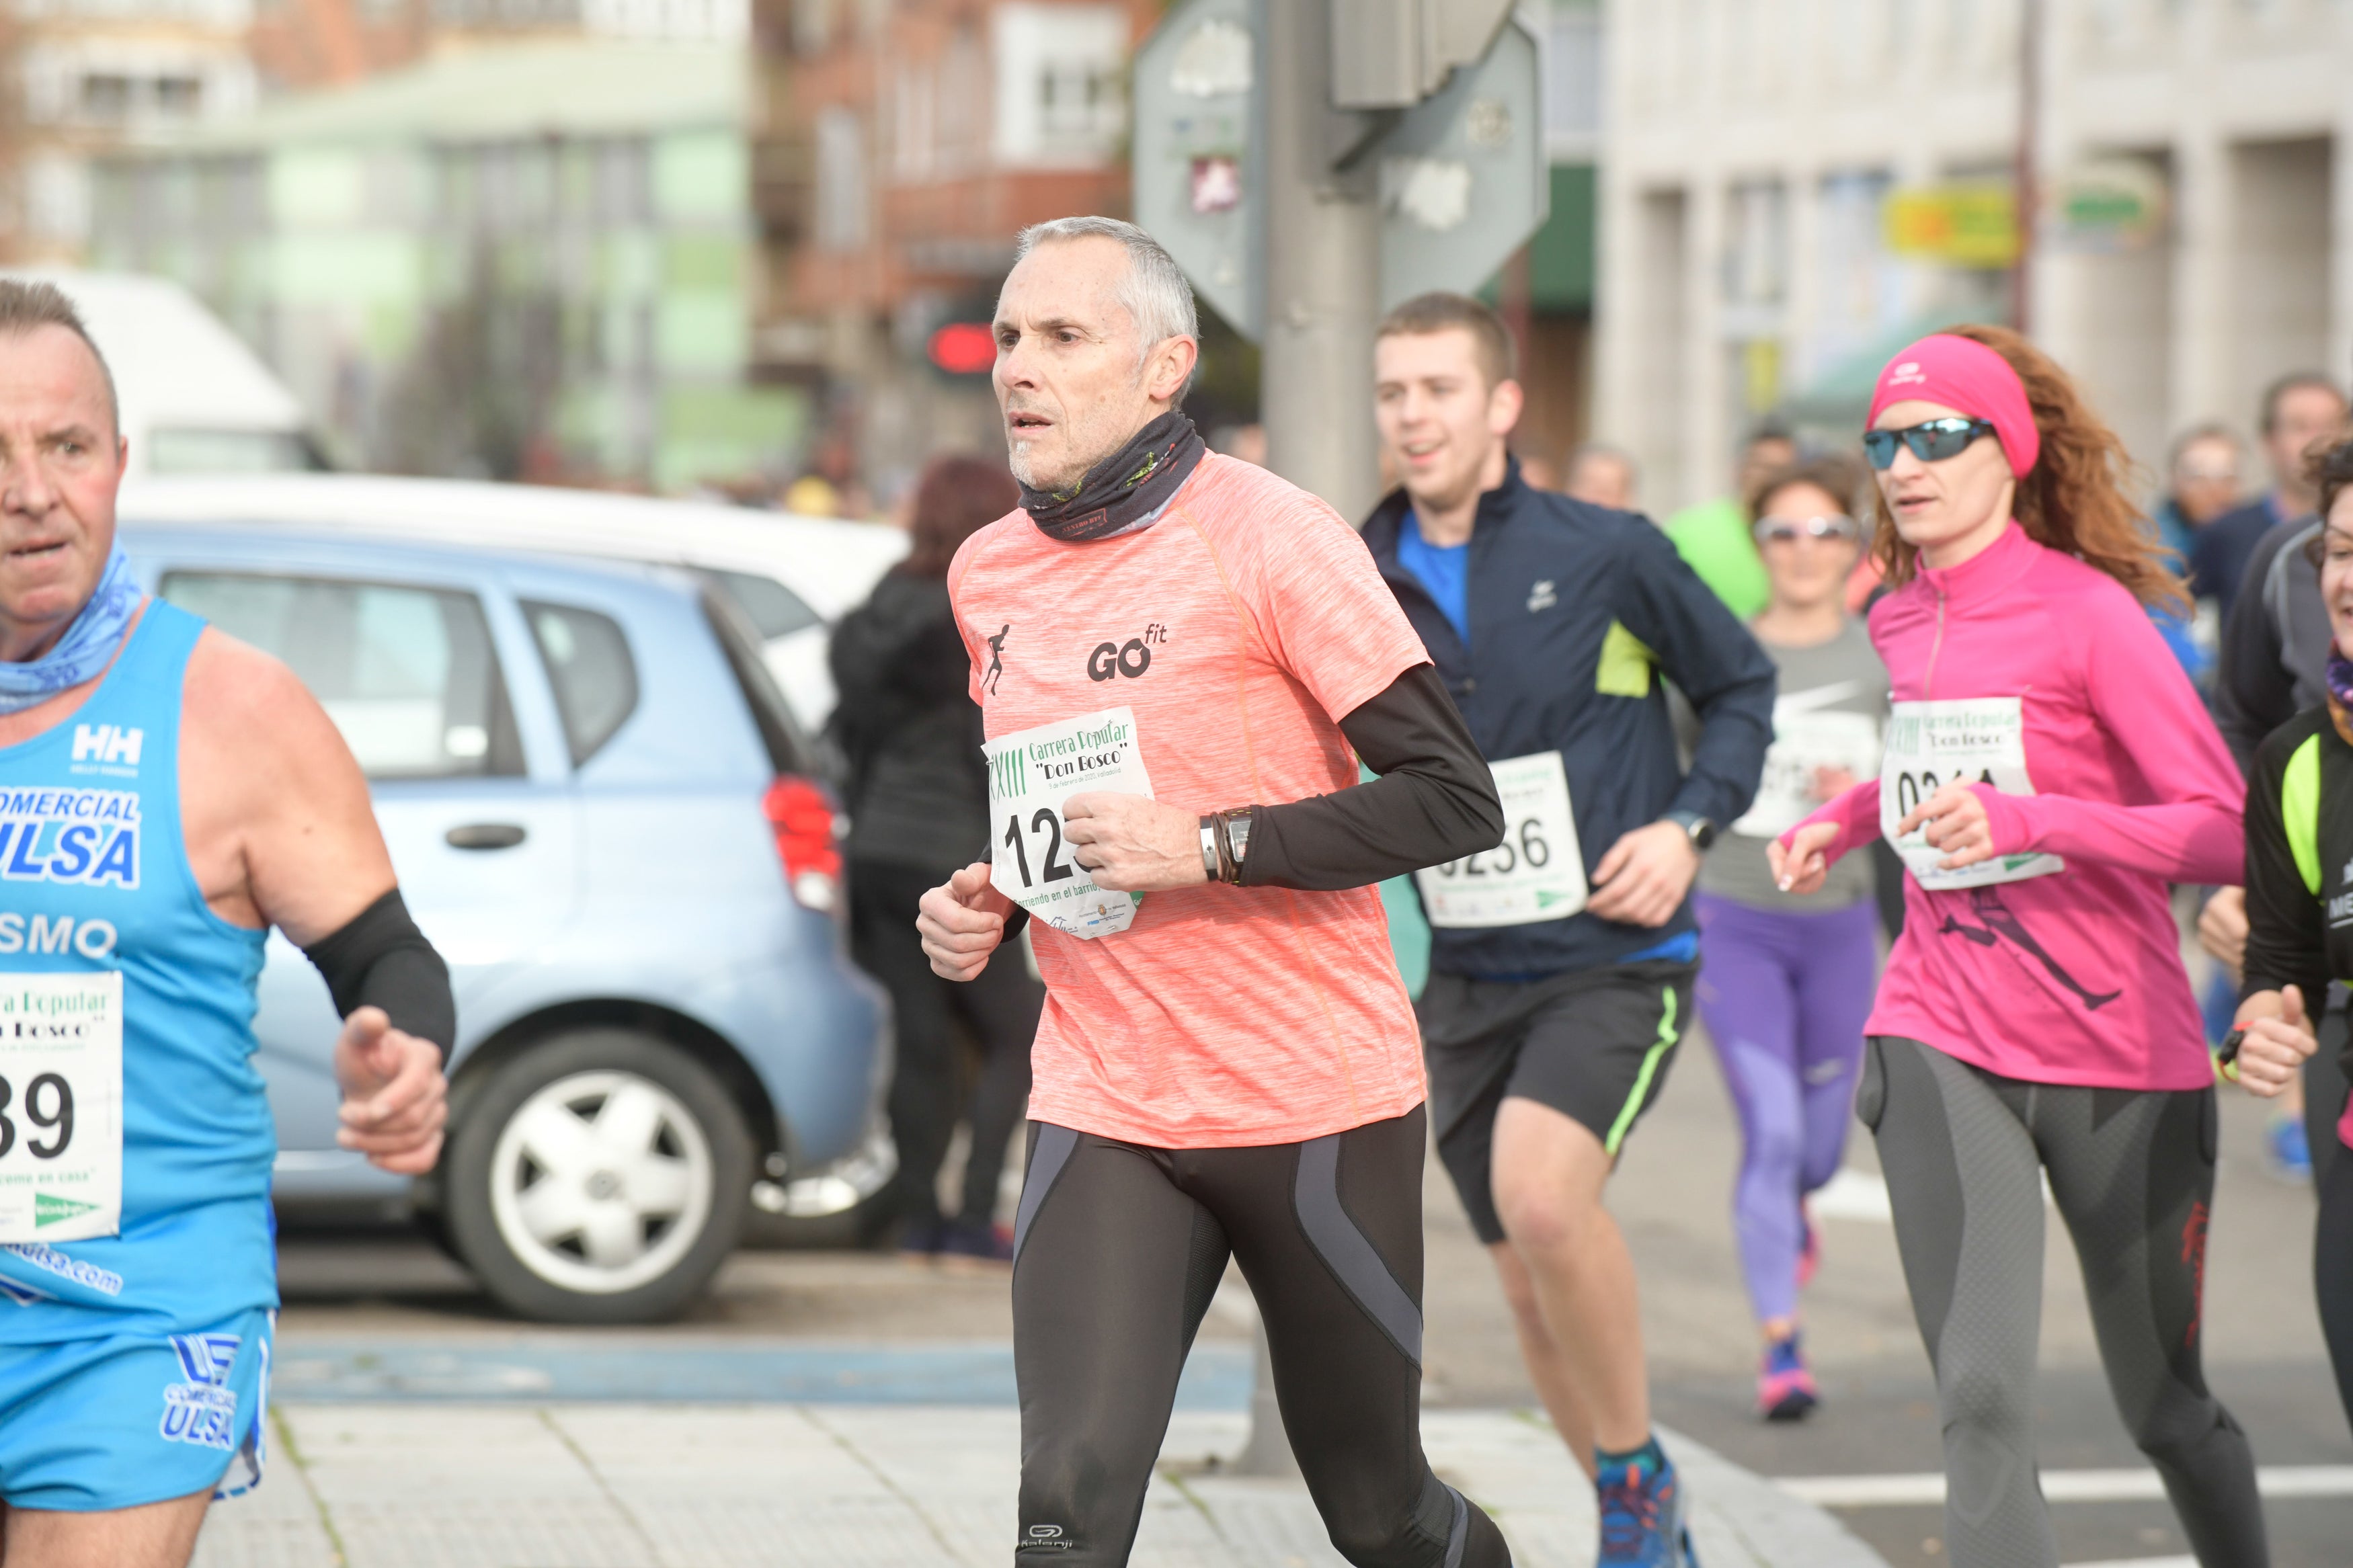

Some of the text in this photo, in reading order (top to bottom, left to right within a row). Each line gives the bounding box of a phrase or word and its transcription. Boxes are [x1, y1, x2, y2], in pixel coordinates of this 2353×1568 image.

[1087, 624, 1167, 682] GO fit
[71, 724, 144, 766] HH
[1029, 723, 1128, 761] Carrera Popular
[1036, 743, 1127, 780] "Don Bosco"
[1060, 778, 1078, 787] febrero
[1051, 891, 1062, 901] en
[1064, 887, 1072, 898] el
[1074, 882, 1101, 896] barrio,
[24, 991, 109, 1018] Popular
[161, 1403, 233, 1449] ULSA
